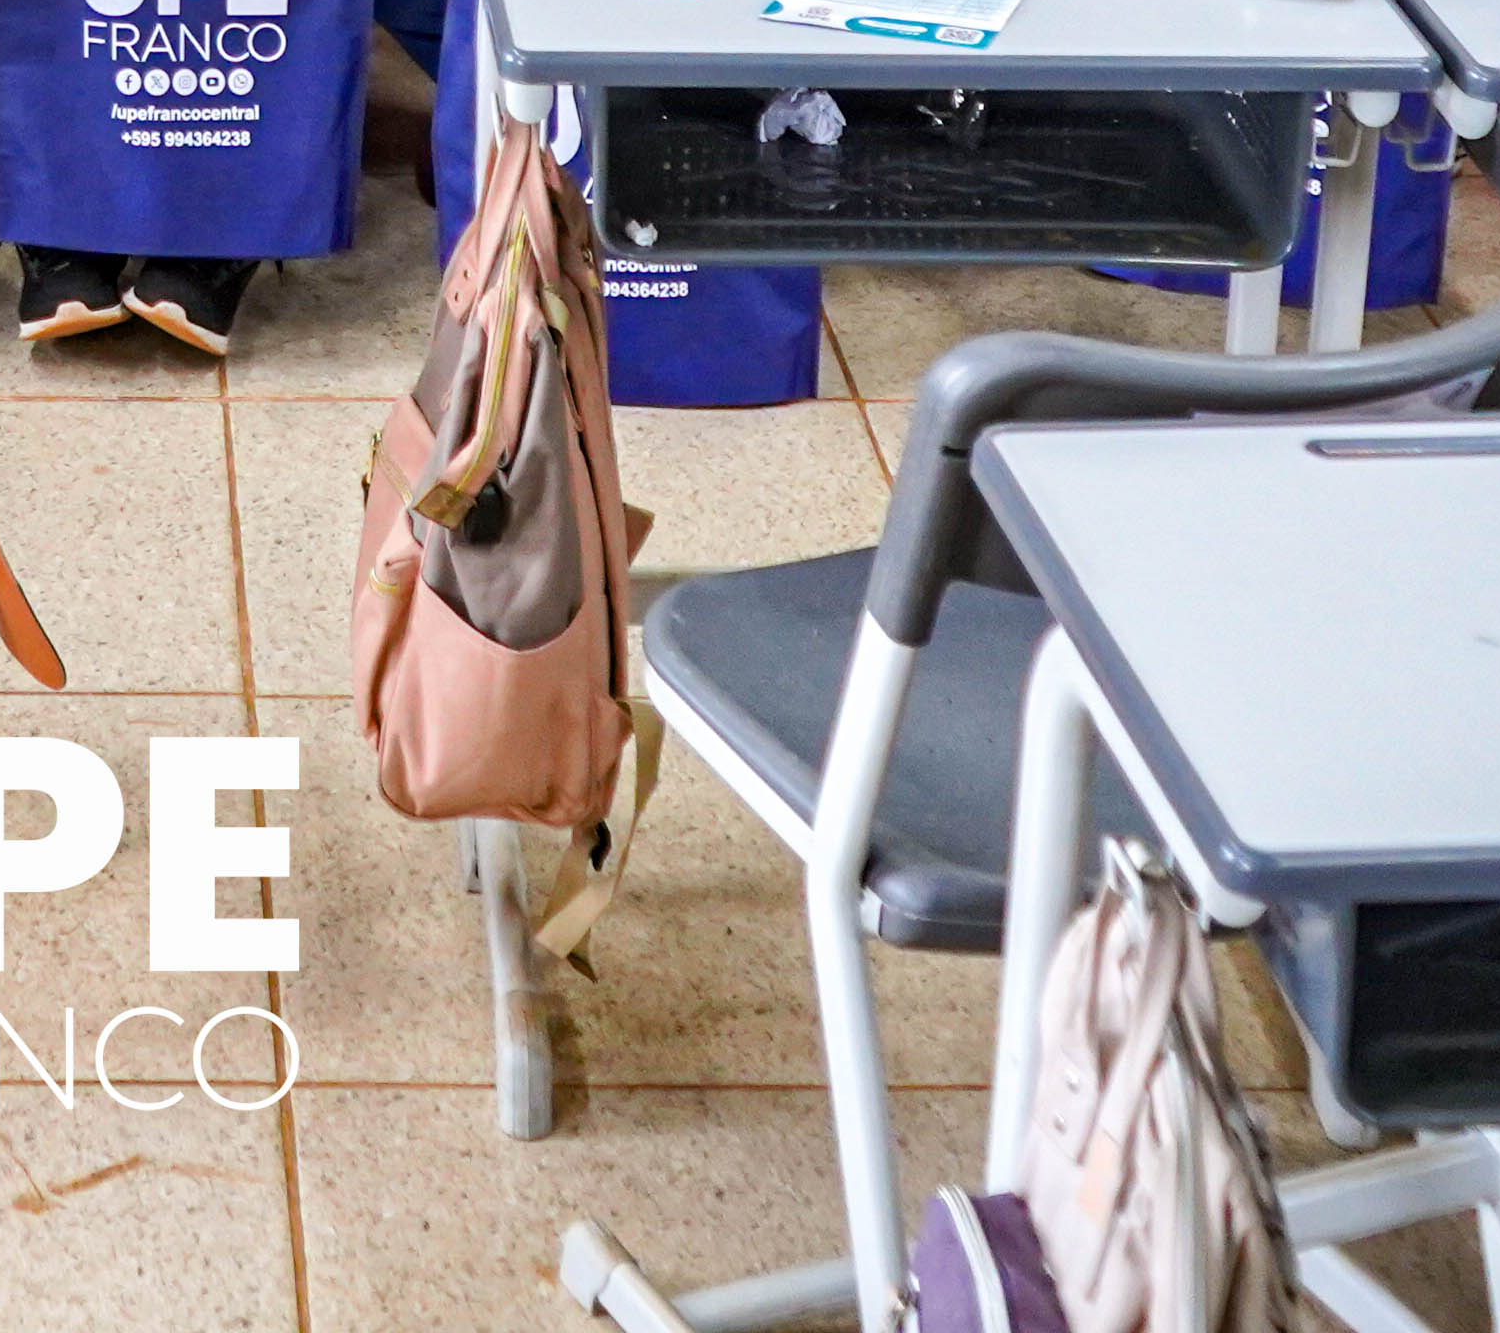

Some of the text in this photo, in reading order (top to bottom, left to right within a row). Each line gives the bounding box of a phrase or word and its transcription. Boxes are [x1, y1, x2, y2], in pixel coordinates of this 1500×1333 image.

[83, 21, 286, 63] FRANCO
[110, 102, 260, 124] /upefrancocentral
[121, 129, 252, 148] +595 994364238
